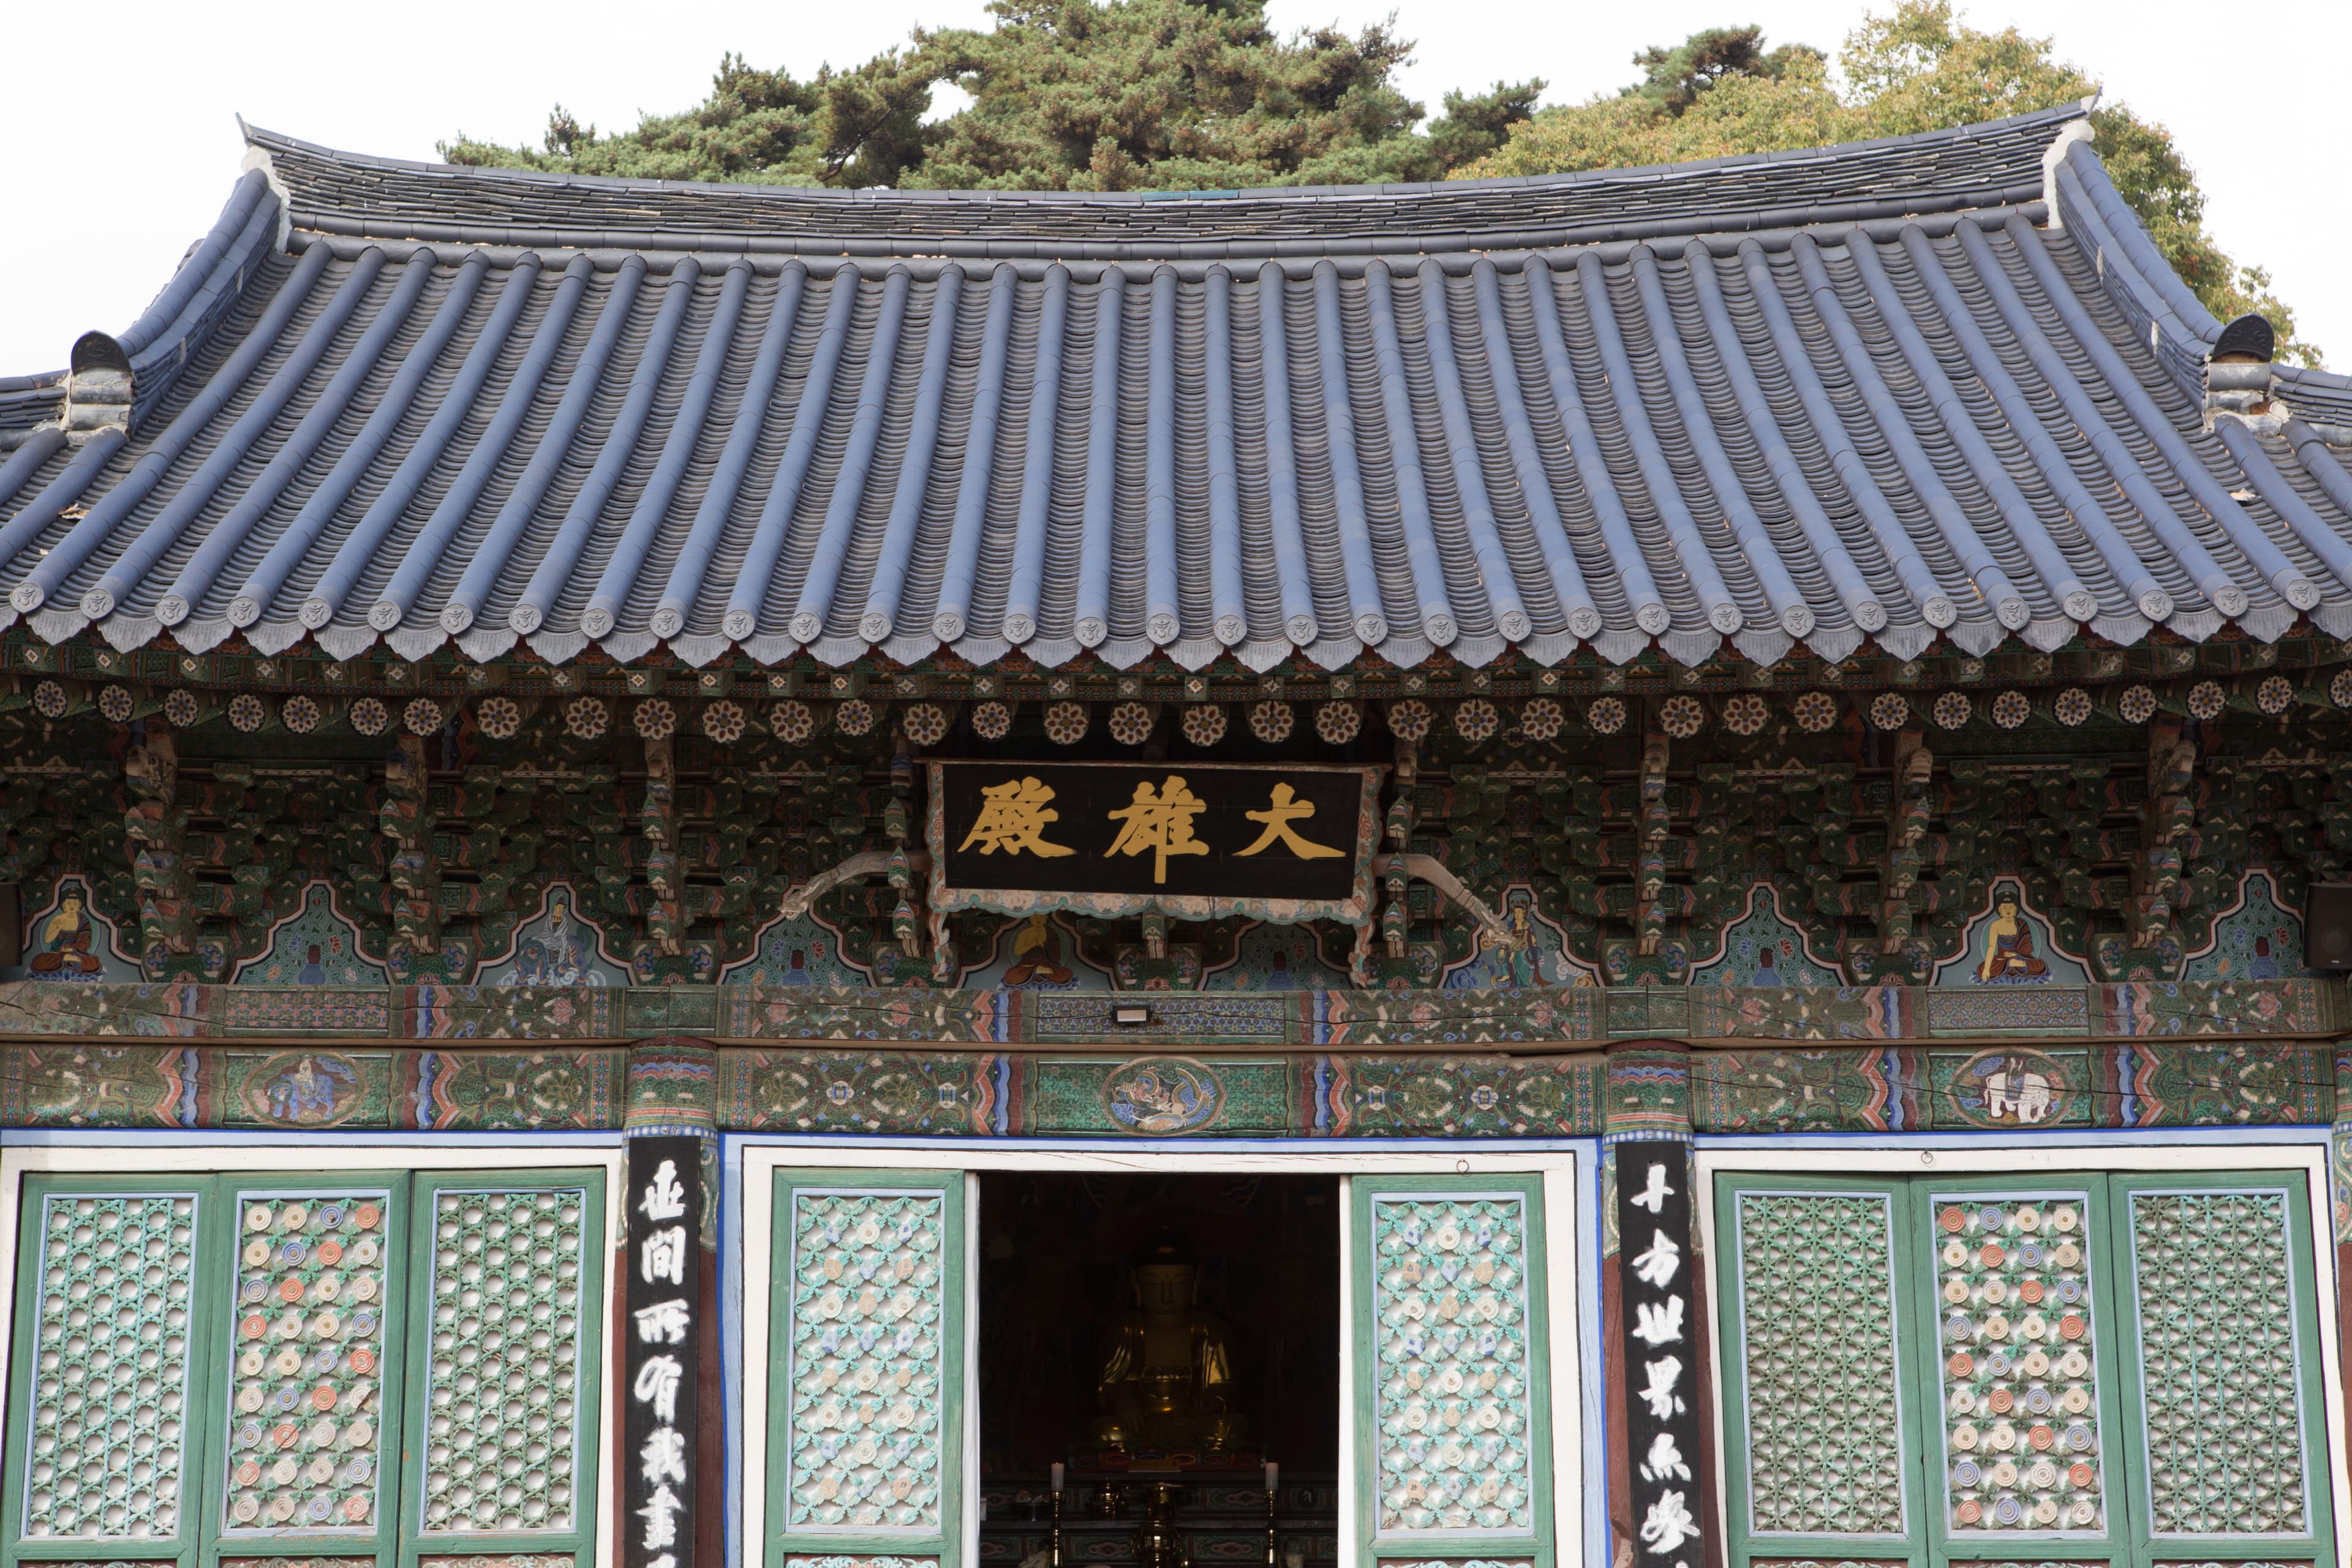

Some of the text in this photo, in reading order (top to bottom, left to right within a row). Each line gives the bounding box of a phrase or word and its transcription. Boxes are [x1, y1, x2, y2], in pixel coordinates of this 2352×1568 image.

[957, 775, 1346, 884] 大雄殿
[633, 1159, 690, 1568] 世間所有我盡
[1630, 1164, 1701, 1568] 十方世界亦無
